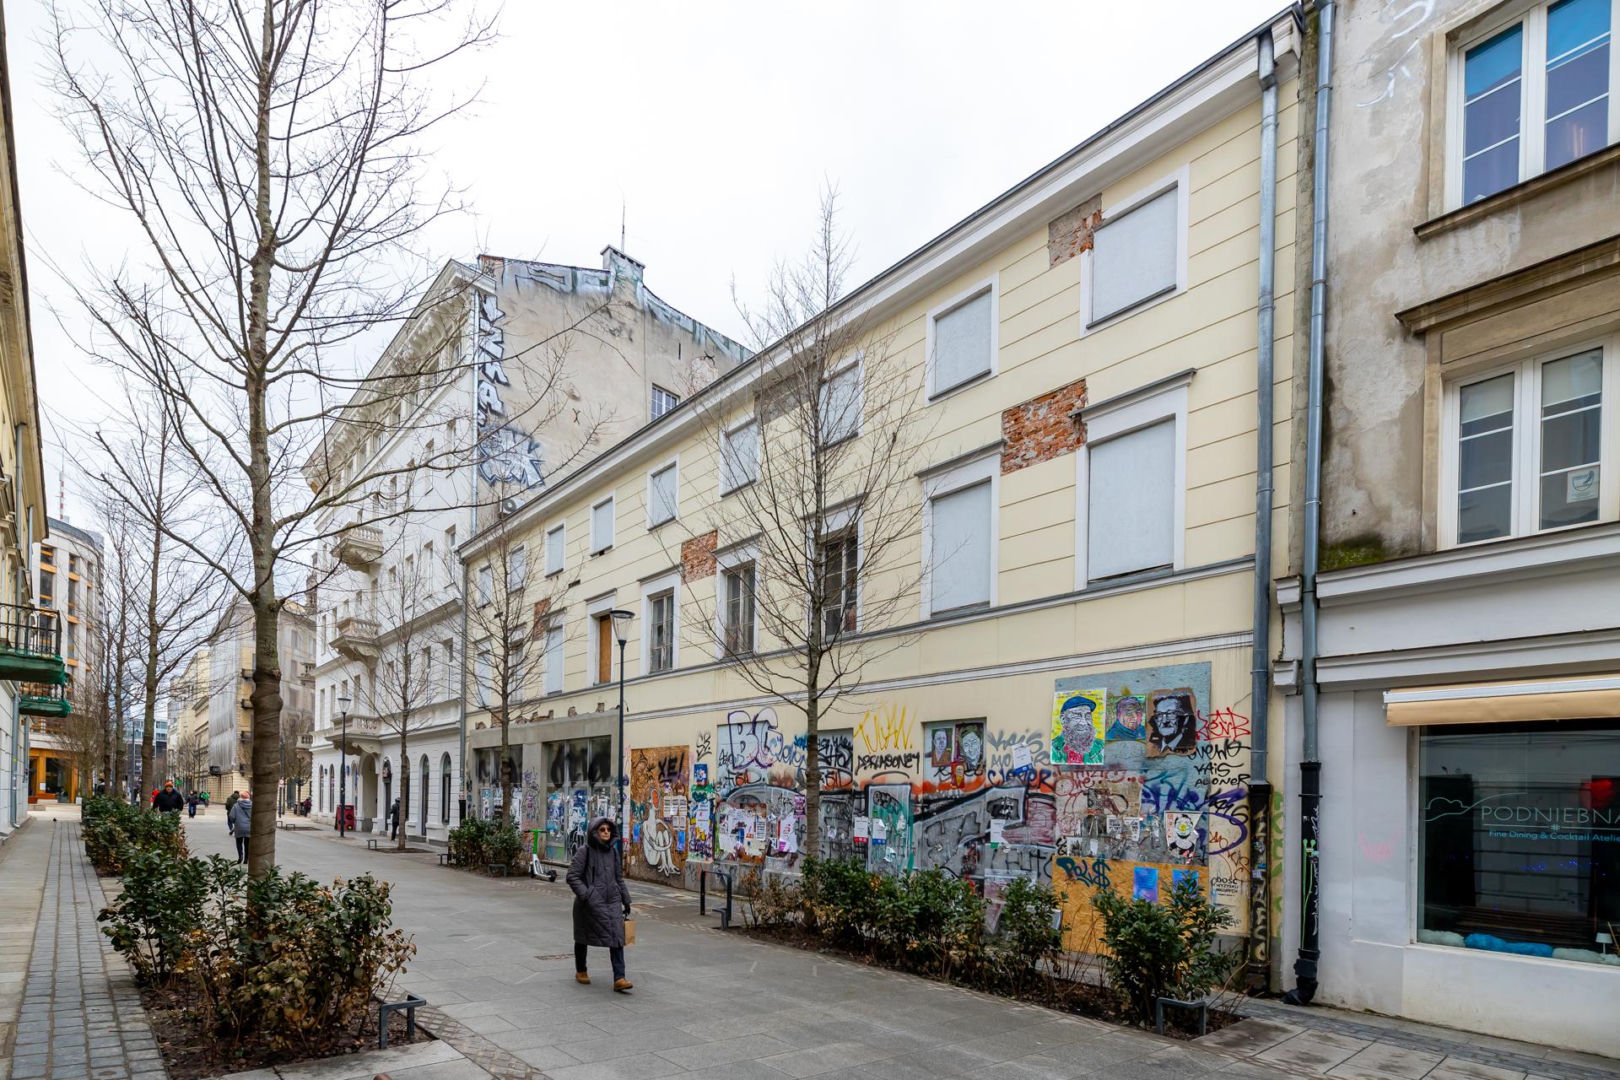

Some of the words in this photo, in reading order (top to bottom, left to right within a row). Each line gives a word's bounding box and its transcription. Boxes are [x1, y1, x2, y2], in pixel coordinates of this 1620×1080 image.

[1489, 830, 1507, 838] Fine
[1509, 830, 1538, 840] Dining
[1550, 831, 1590, 840] Cocktail
